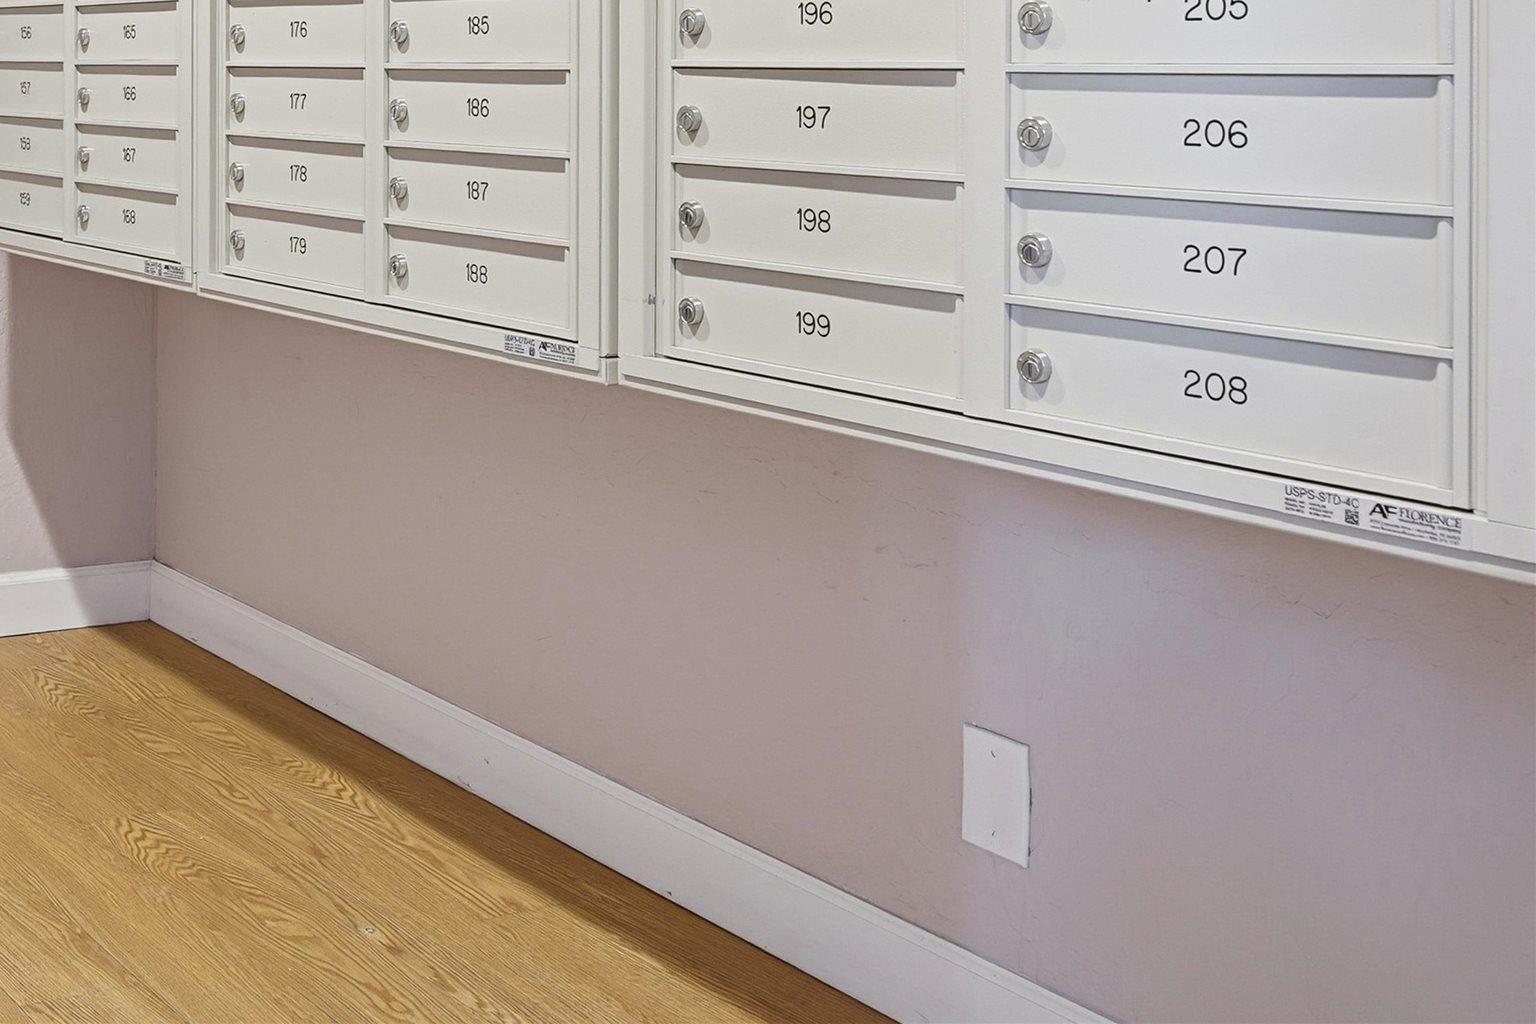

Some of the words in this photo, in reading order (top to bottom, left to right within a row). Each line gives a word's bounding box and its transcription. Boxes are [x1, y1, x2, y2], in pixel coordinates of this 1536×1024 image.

[797, 0, 834, 26] 196
[122, 24, 137, 40] 165
[289, 20, 308, 38] 176
[466, 15, 490, 36] 185
[122, 85, 137, 102] 166
[289, 92, 307, 110] 177
[466, 97, 490, 118] 186
[795, 105, 832, 130] 197
[1183, 118, 1249, 150] 206
[122, 147, 137, 163] 167
[289, 164, 308, 183] 178
[466, 180, 490, 201] 187
[122, 208, 137, 225] 168
[796, 207, 832, 234] 198
[289, 235, 307, 255] 179
[1183, 244, 1248, 277] 207
[465, 262, 489, 285] 188
[795, 310, 831, 338] 199
[1183, 369, 1248, 406] 208
[1284, 484, 1360, 509] USPS-STD-4C
[1399, 506, 1462, 529] FLORENCE
